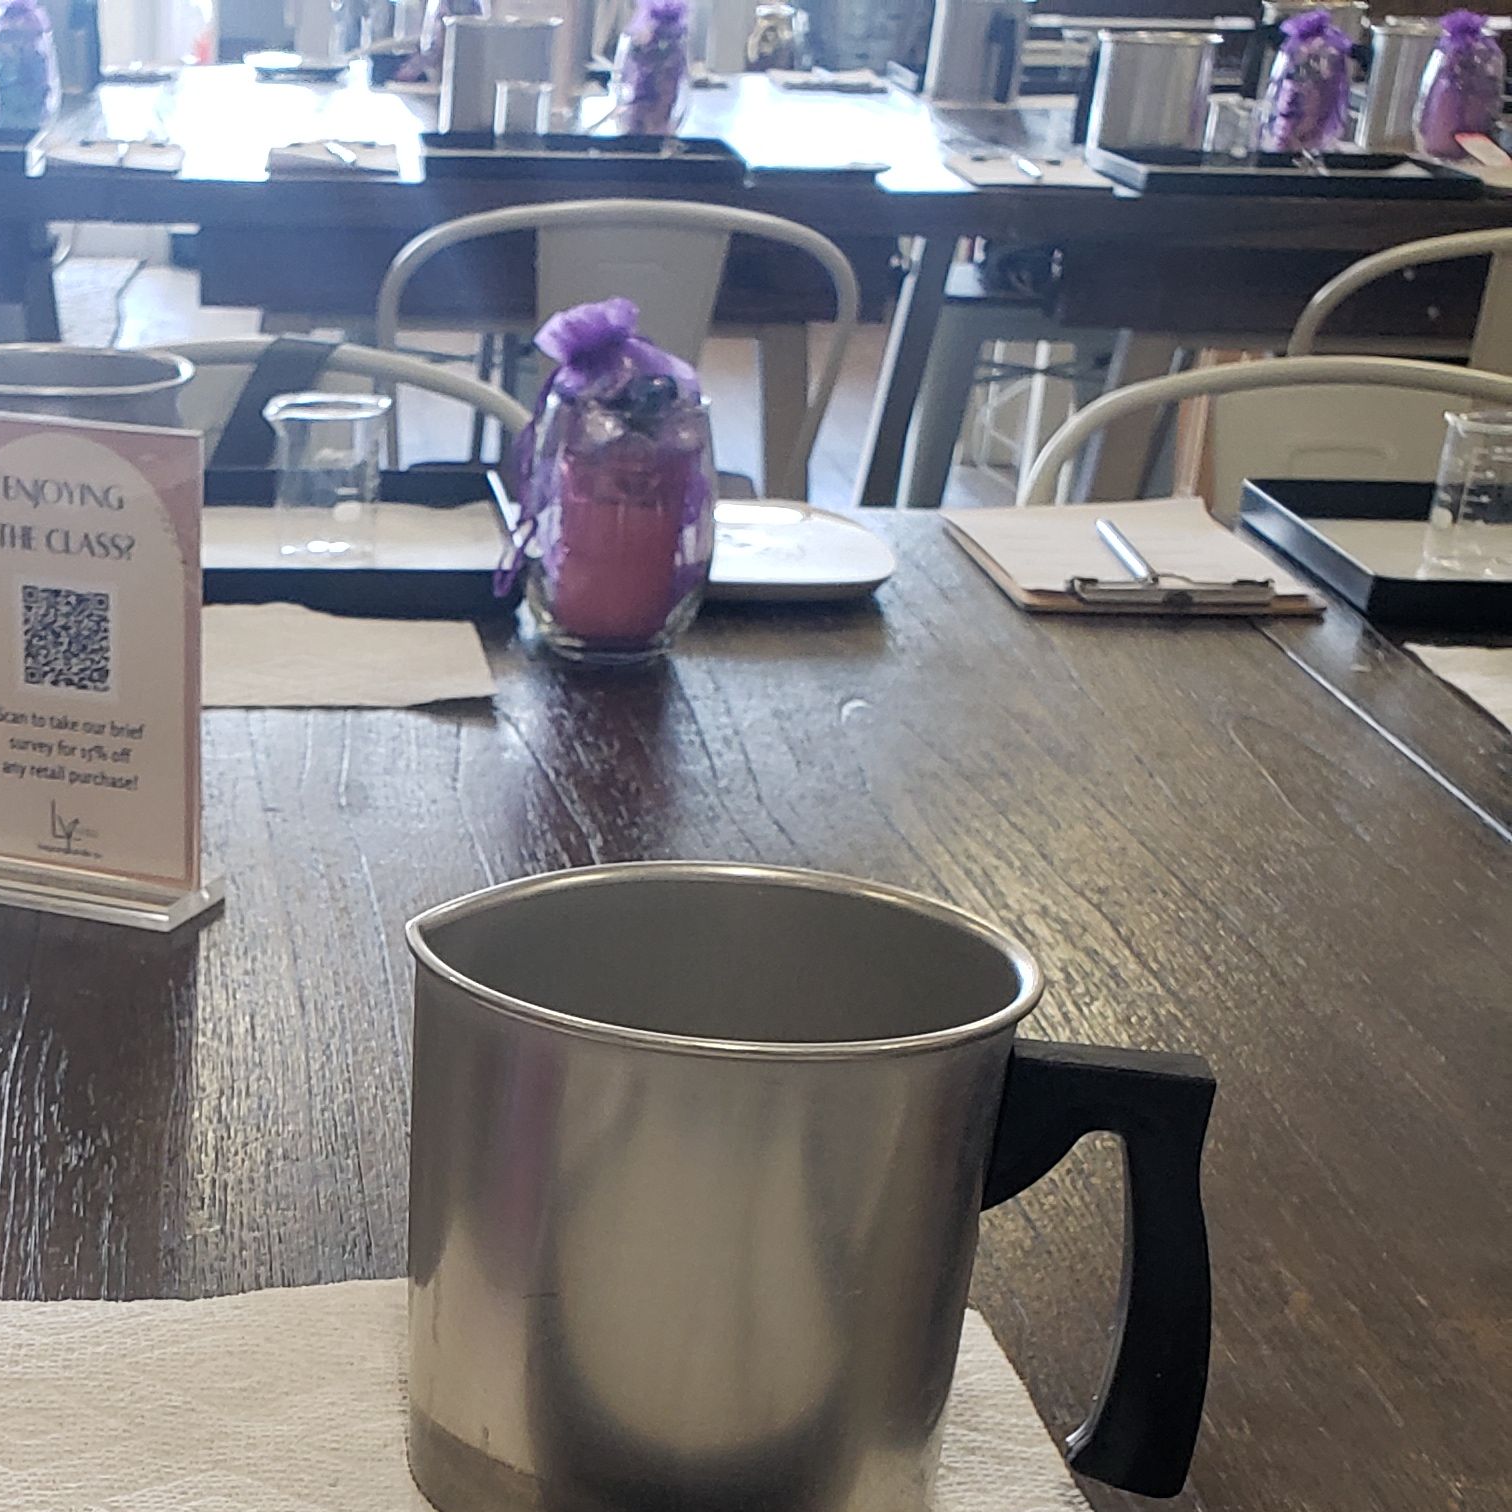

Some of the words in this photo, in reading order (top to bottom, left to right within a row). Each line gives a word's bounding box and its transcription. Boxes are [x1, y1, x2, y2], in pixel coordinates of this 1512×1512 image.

[2, 475, 125, 511] ENJOYING
[45, 527, 137, 561] CLASS?
[31, 712, 46, 728] to
[49, 714, 79, 732] take
[82, 721, 107, 735] our
[110, 720, 145, 740] brief
[8, 737, 54, 757] survey
[57, 739, 78, 757] for
[110, 746, 134, 764] off
[2, 761, 27, 779] any
[29, 764, 65, 781] retail
[67, 770, 139, 791] purchase!
